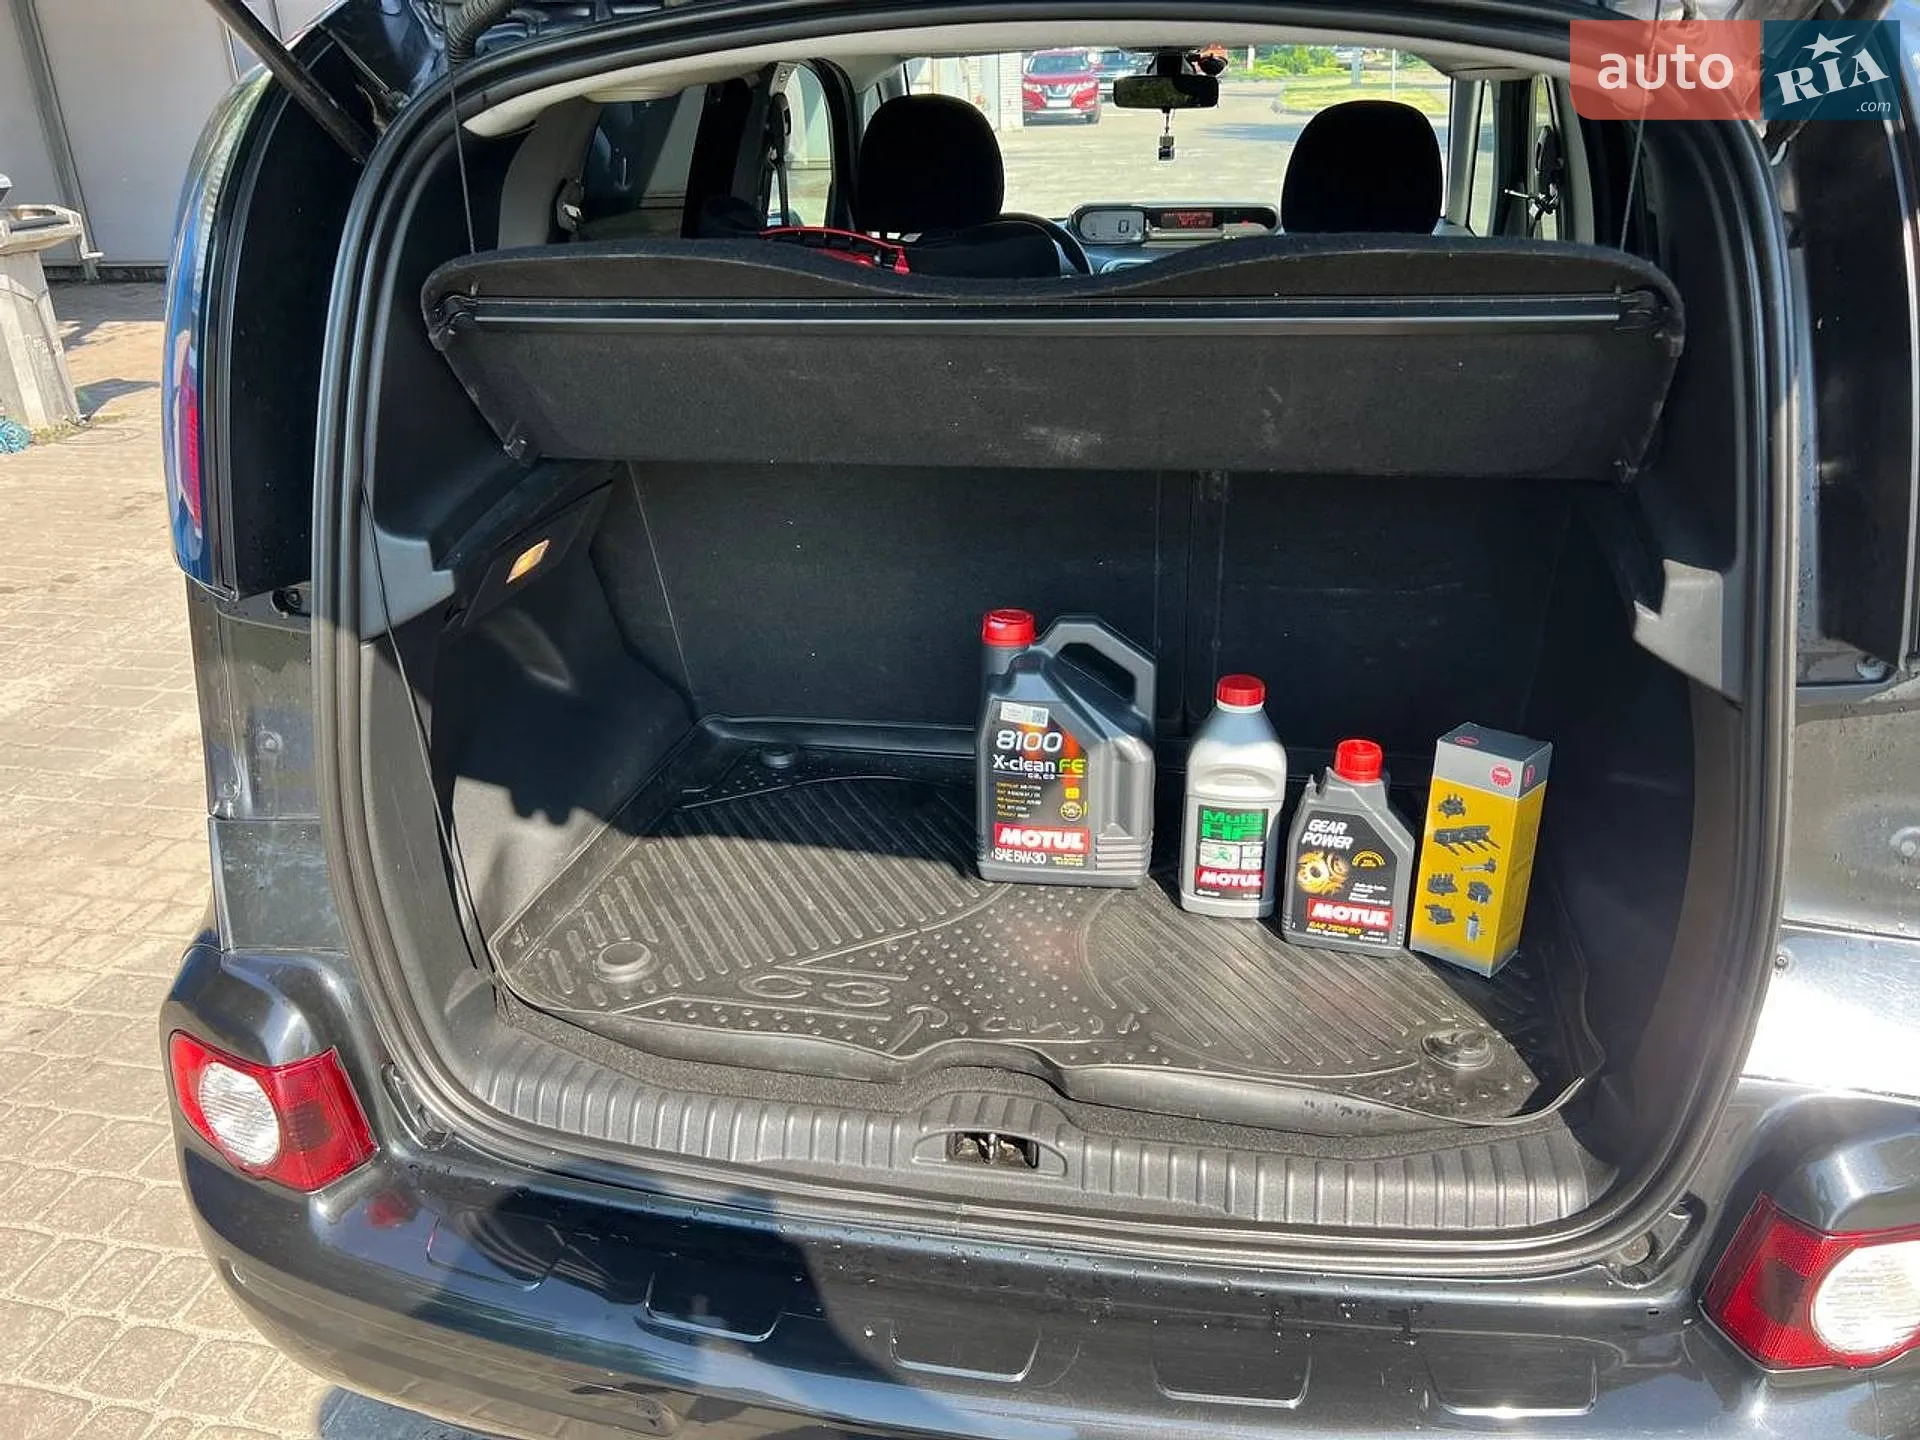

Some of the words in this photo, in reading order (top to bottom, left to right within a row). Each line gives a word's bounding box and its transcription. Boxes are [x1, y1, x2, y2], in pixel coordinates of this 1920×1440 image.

[996, 729, 1063, 752] 8100
[993, 754, 1056, 773] X-clean
[1059, 758, 1087, 774] FE
[1308, 819, 1347, 835] GEAR
[999, 827, 1084, 850] MOTUL
[1301, 831, 1354, 850] POWER
[1200, 871, 1262, 887] MOTUL
[1311, 902, 1389, 926] MOTUL
